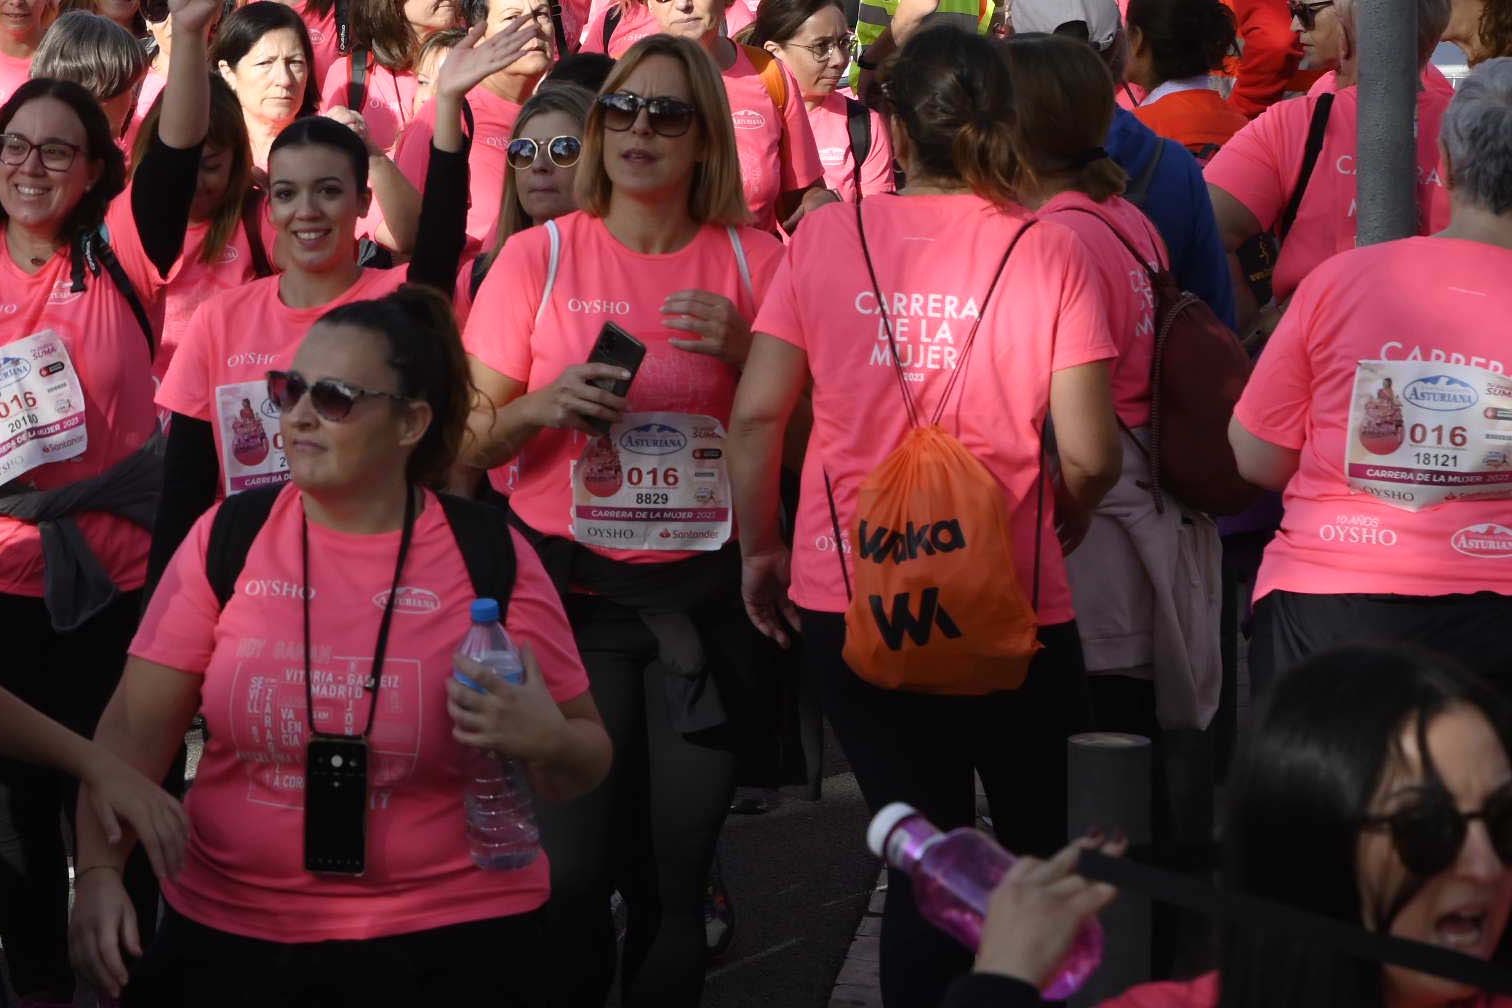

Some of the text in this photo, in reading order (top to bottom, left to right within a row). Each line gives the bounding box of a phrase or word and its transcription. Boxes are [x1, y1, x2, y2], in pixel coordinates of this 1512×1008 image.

[567, 298, 630, 316] OYSHO
[855, 291, 981, 321] CARRERA
[878, 317, 955, 345] DE LA
[869, 344, 959, 371] MUJER
[1407, 388, 1473, 405] ASTURIANA
[625, 434, 683, 449] ASTURIANA
[1409, 422, 1468, 447] 016
[1414, 452, 1458, 468] 18121
[244, 474, 283, 487] CARRERA
[627, 466, 680, 487] 016
[1366, 467, 1415, 481] CARRERA
[1416, 472, 1432, 482] DE
[1432, 473, 1448, 483] LA
[1448, 474, 1482, 483] MUJER
[635, 492, 670, 505] 8829
[1362, 485, 1415, 502] OYSHO
[591, 510, 634, 519] CARRERA
[635, 510, 648, 519] DE
[649, 510, 662, 519] LA
[663, 510, 694, 520] MUJER
[586, 527, 634, 540] OYSHO
[1319, 523, 1398, 548] OYSHO
[245, 578, 317, 601] OYSHO
[280, 709, 295, 720] VA
